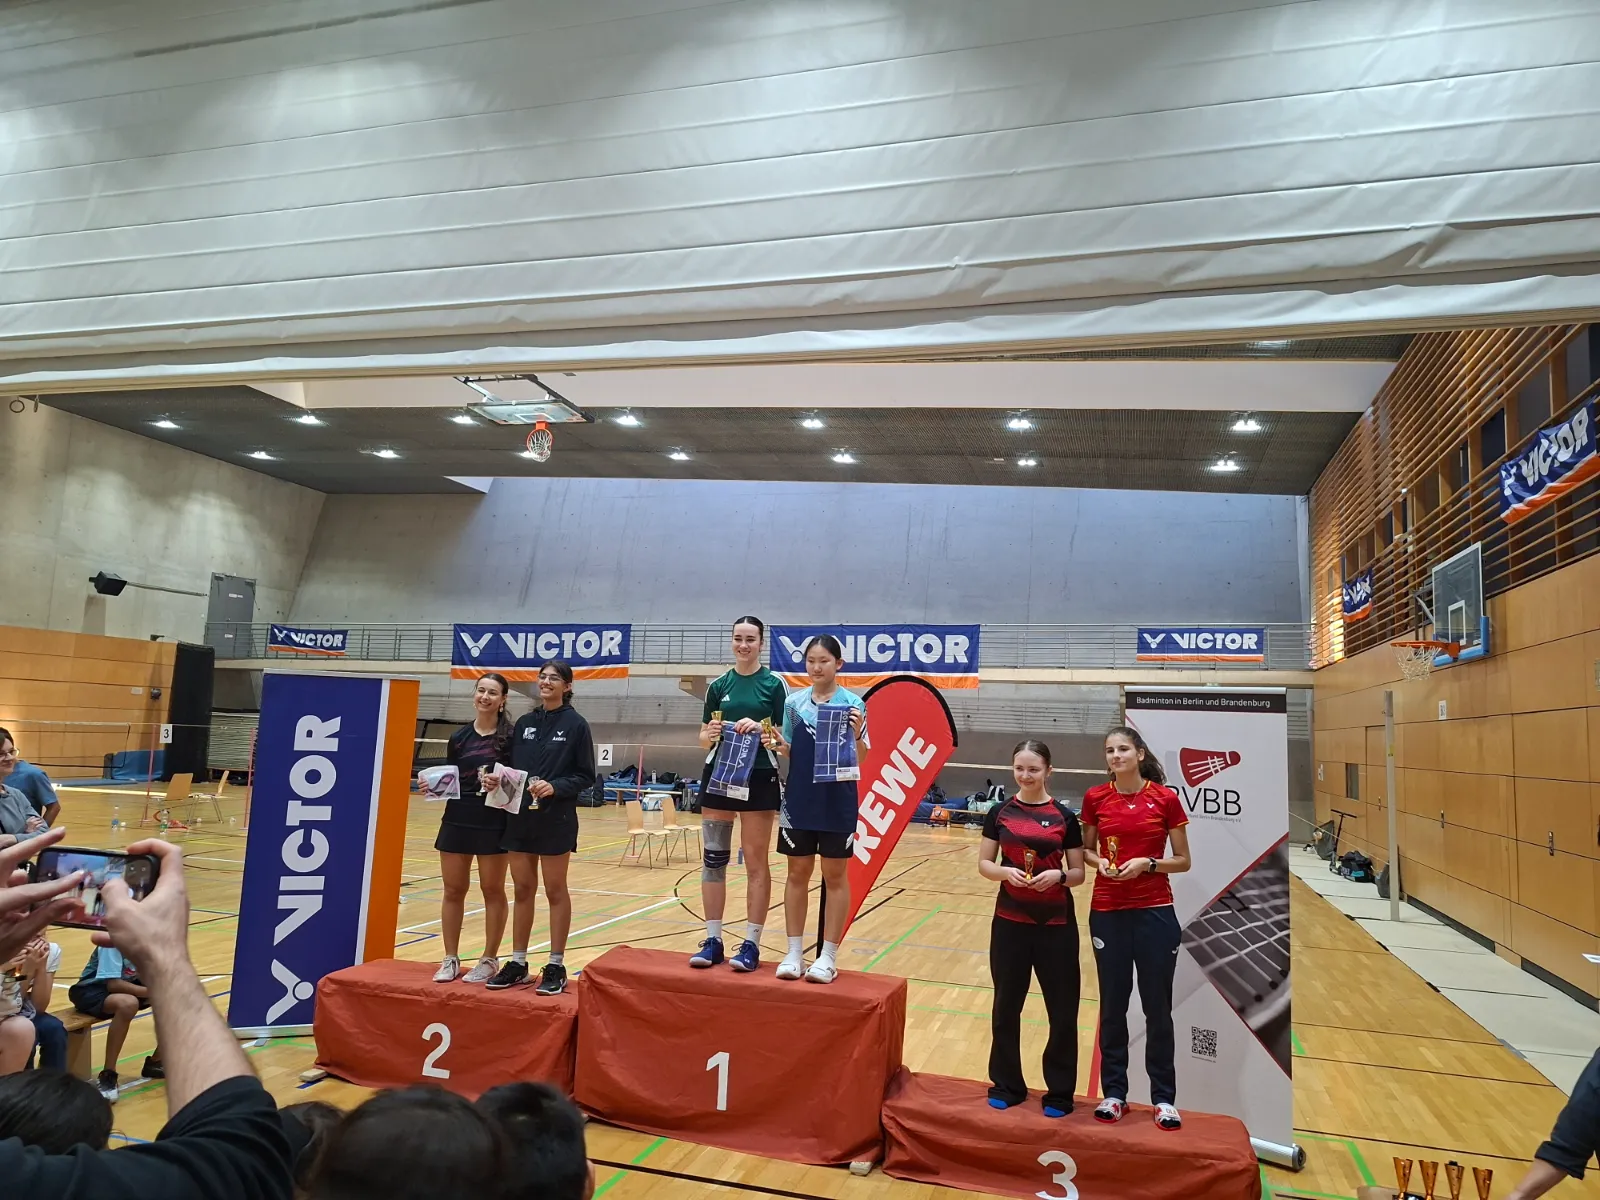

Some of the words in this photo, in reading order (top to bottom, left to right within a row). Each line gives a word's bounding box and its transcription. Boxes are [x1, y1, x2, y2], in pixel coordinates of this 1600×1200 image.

[1519, 407, 1589, 487] VICTOR
[290, 631, 344, 647] VICTOR
[500, 630, 623, 659] VICTOR
[1170, 632, 1258, 650] VICTOR
[1136, 696, 1174, 705] Badminton
[1174, 697, 1182, 705] in
[1182, 697, 1204, 706] Berlin
[1205, 698, 1220, 706] und
[1220, 698, 1271, 709] Brandenburg
[163, 728, 170, 739] 3
[602, 749, 609, 761] 2
[853, 726, 937, 866] REWE
[274, 714, 342, 946] VICTOR
[421, 1022, 451, 1080] 2
[705, 1051, 730, 1112] 1
[1035, 1150, 1079, 1200] 3
